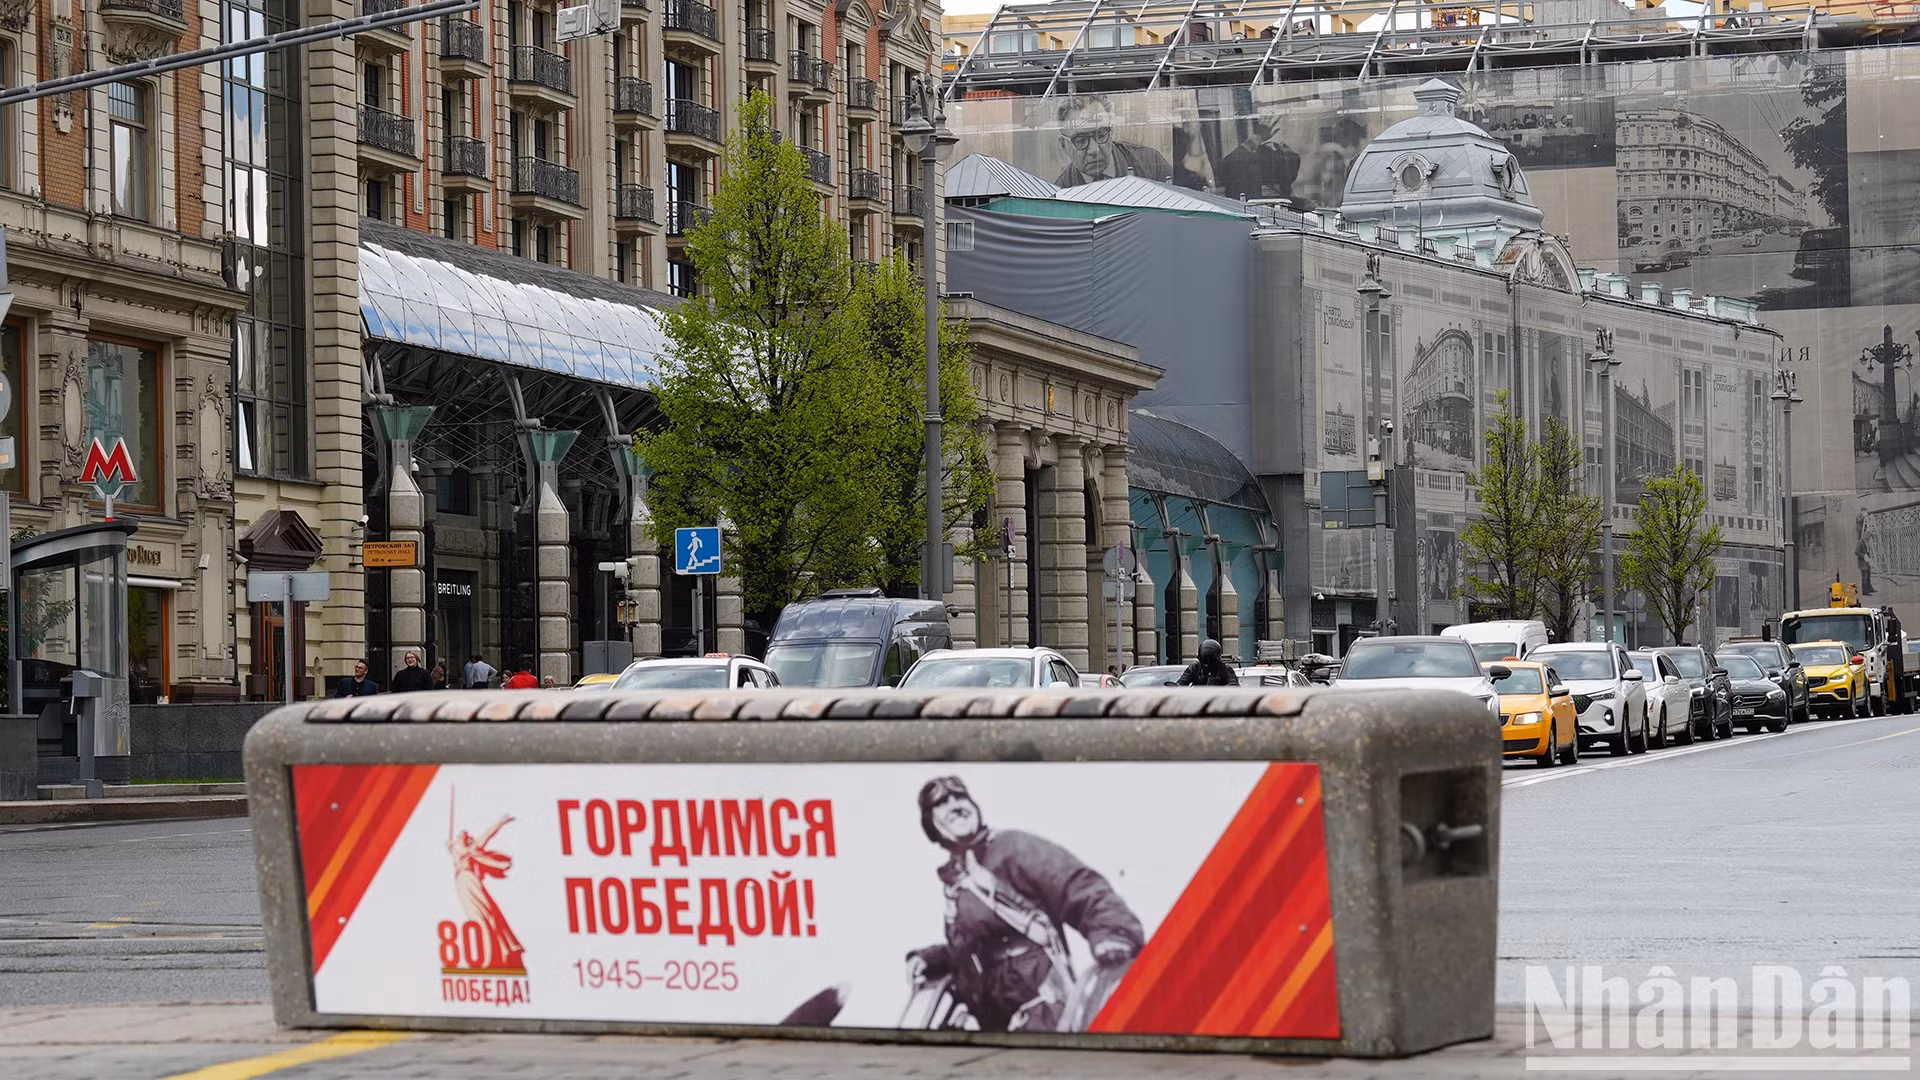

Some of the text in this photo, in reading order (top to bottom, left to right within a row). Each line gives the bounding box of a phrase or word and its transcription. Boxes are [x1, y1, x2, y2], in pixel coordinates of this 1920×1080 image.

[437, 583, 472, 596] BREITLING
[556, 799, 837, 867] ГОРДИМСЯ
[564, 870, 818, 947] ПОБЕДОЙ!
[437, 920, 486, 969] 80
[441, 977, 530, 1007] ПОБЕДА!
